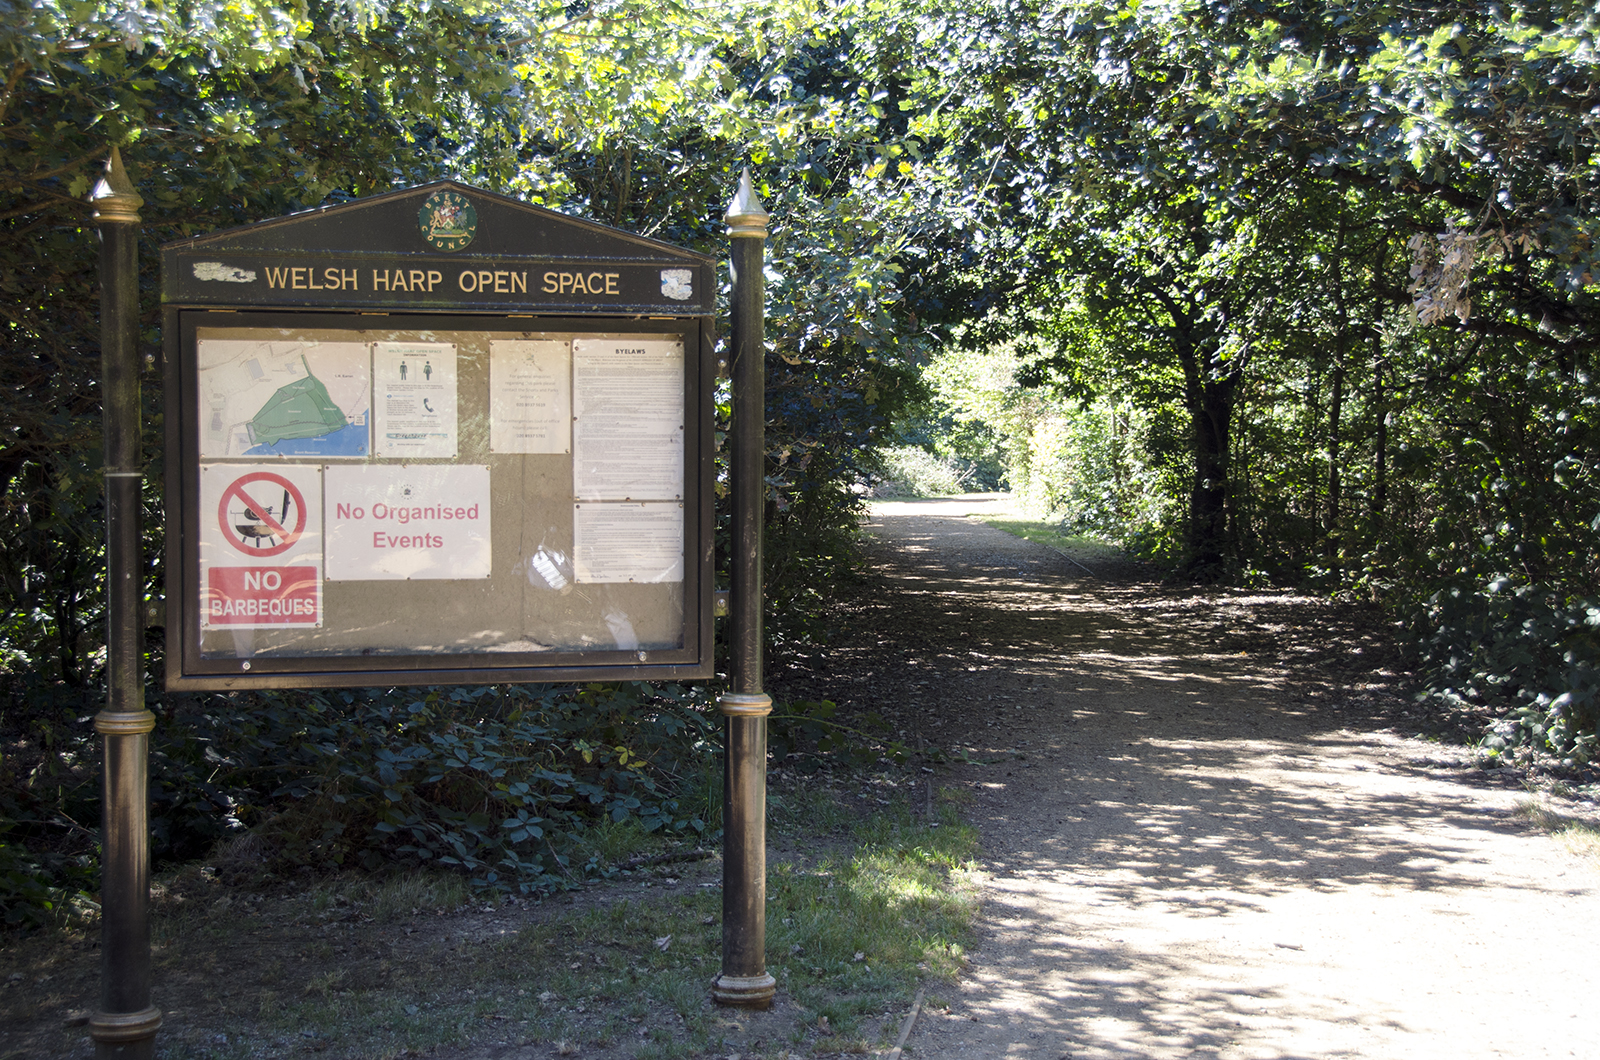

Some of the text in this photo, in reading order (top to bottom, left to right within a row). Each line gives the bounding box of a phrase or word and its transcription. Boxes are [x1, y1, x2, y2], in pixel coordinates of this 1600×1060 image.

[425, 194, 470, 209] BRENT
[421, 225, 476, 249] COUNCIL
[264, 266, 621, 295] WELSH HARP OPEN SPACE
[336, 502, 479, 523] No Organised
[373, 531, 444, 549] Events
[243, 571, 282, 591] NO
[211, 598, 314, 618] BARBEQUES
